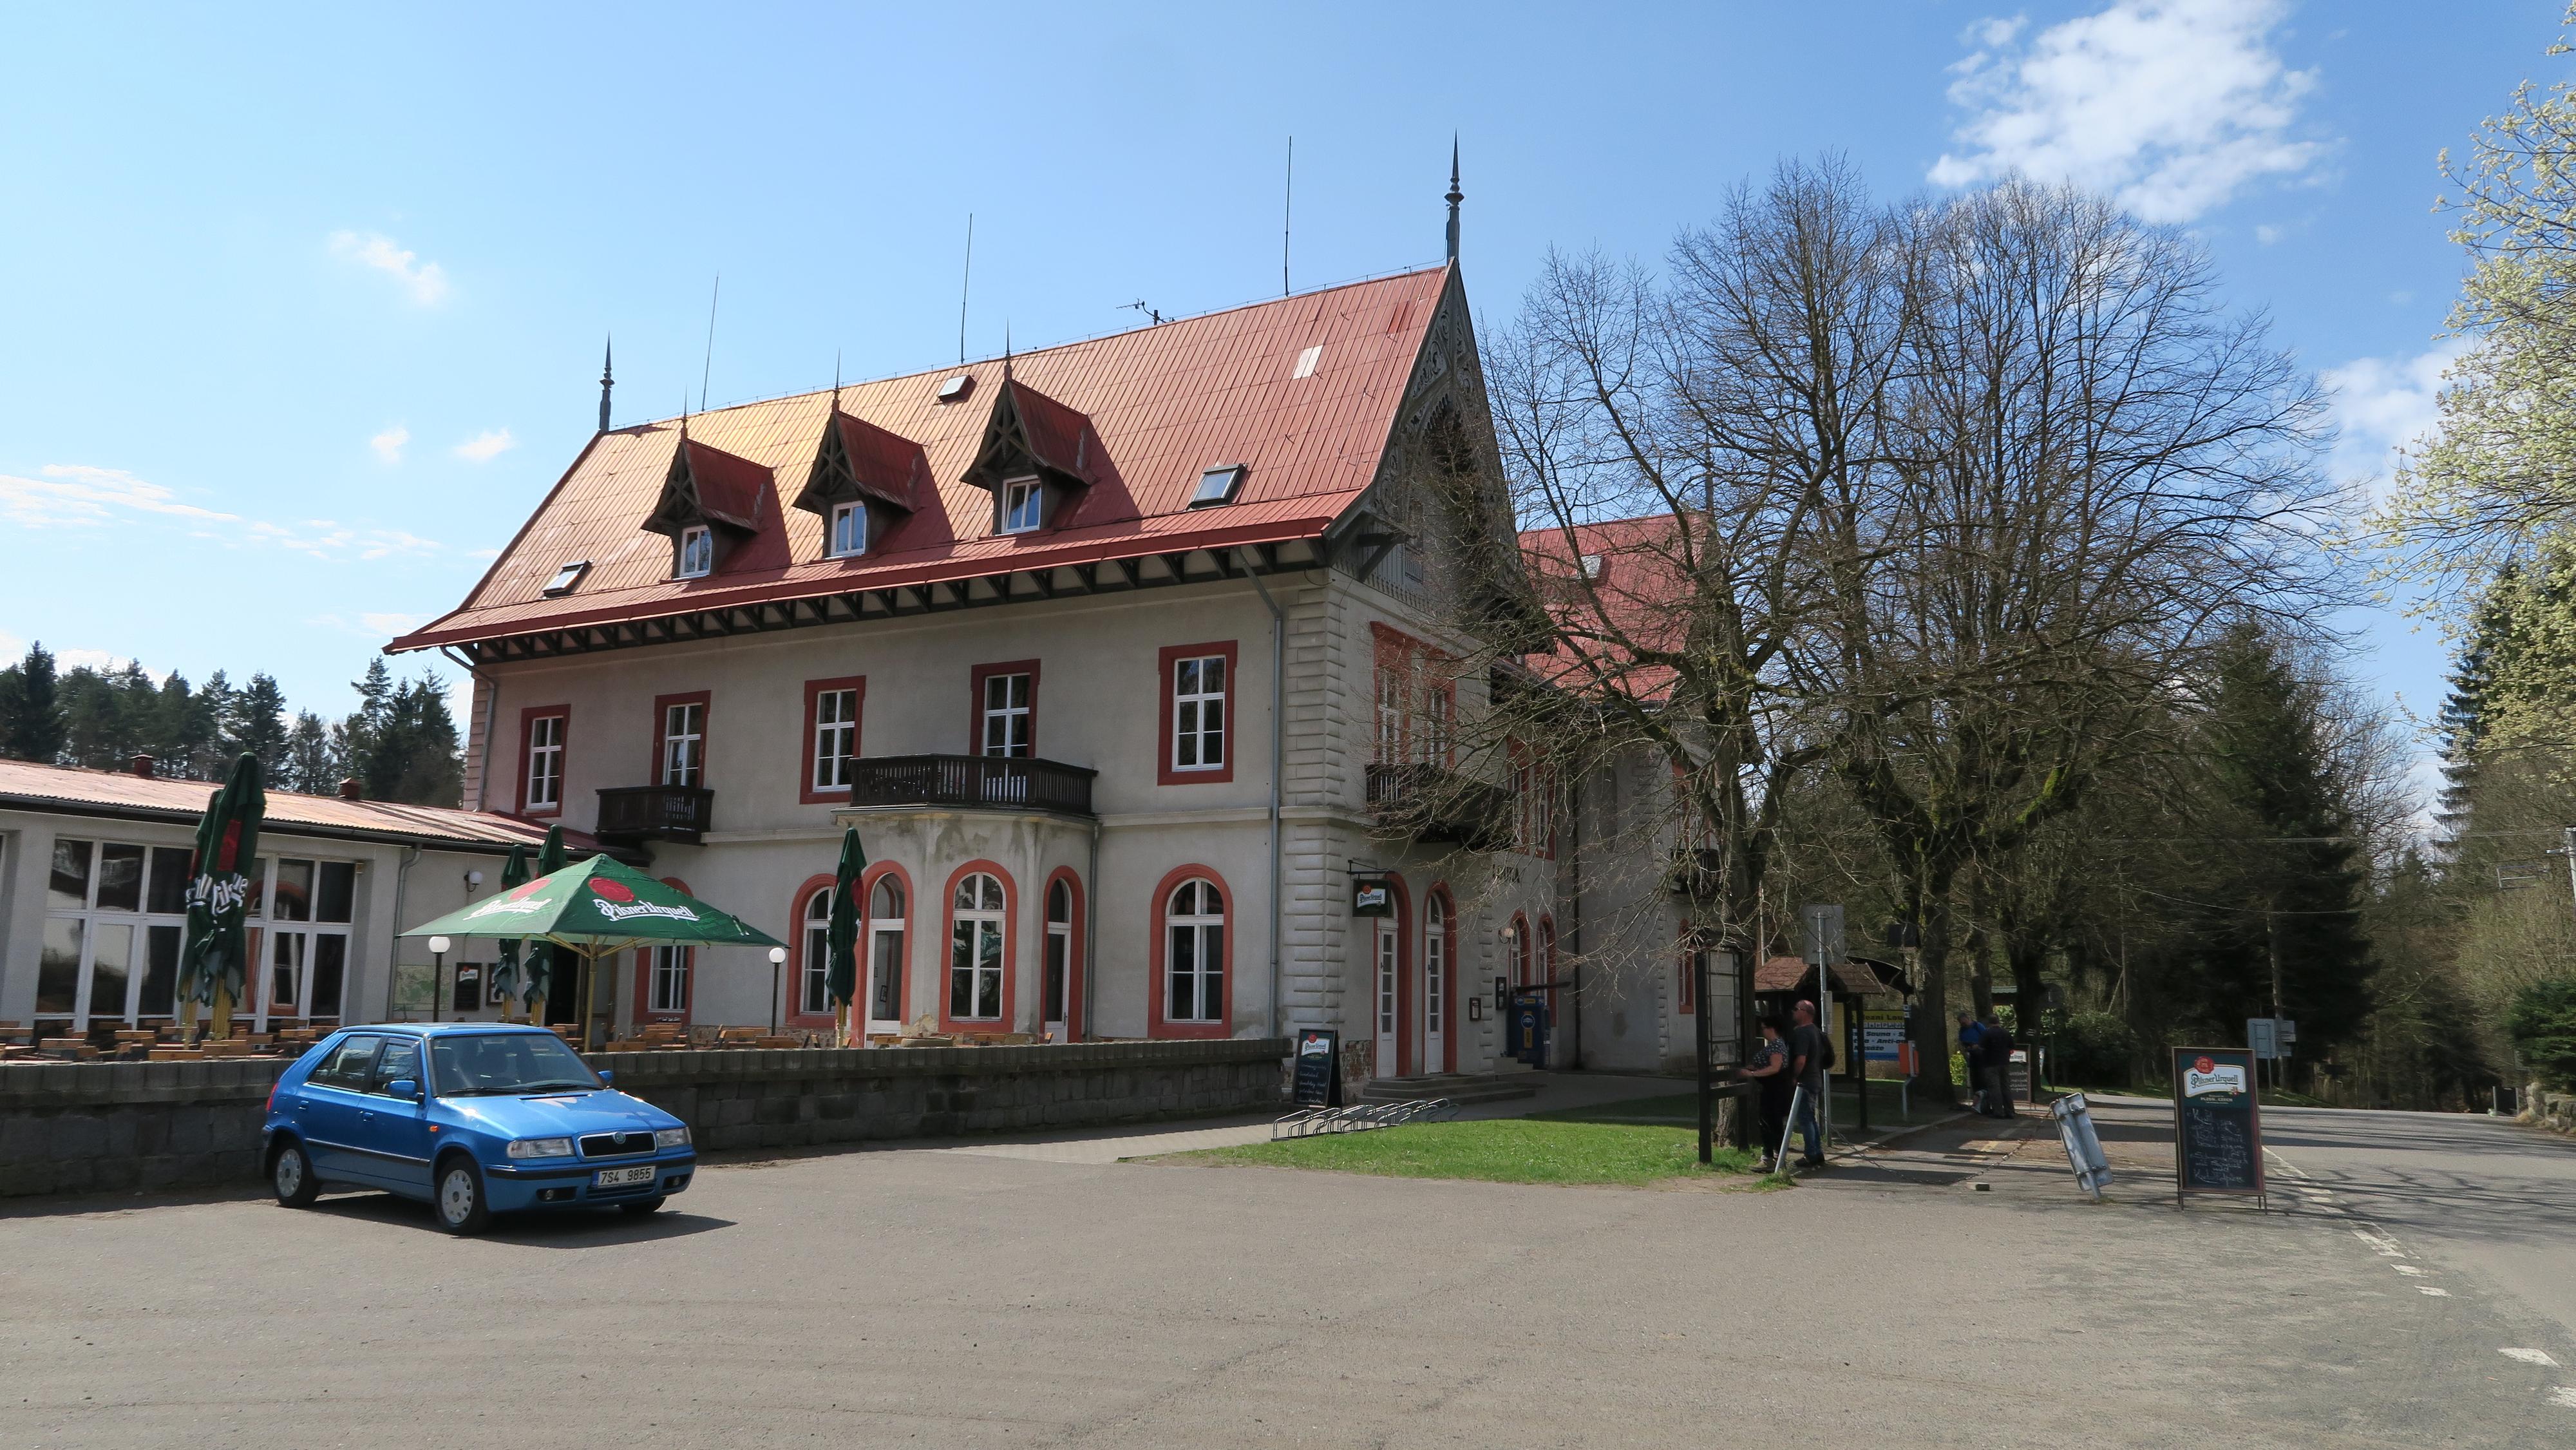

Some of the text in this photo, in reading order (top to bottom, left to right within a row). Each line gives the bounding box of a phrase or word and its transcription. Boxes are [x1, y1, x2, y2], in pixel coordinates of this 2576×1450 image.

[592, 899, 699, 922] Pilsner Urquell
[2191, 1073, 2239, 1089] Pilsner Urquell
[601, 1168, 651, 1184] 7S4 9855
